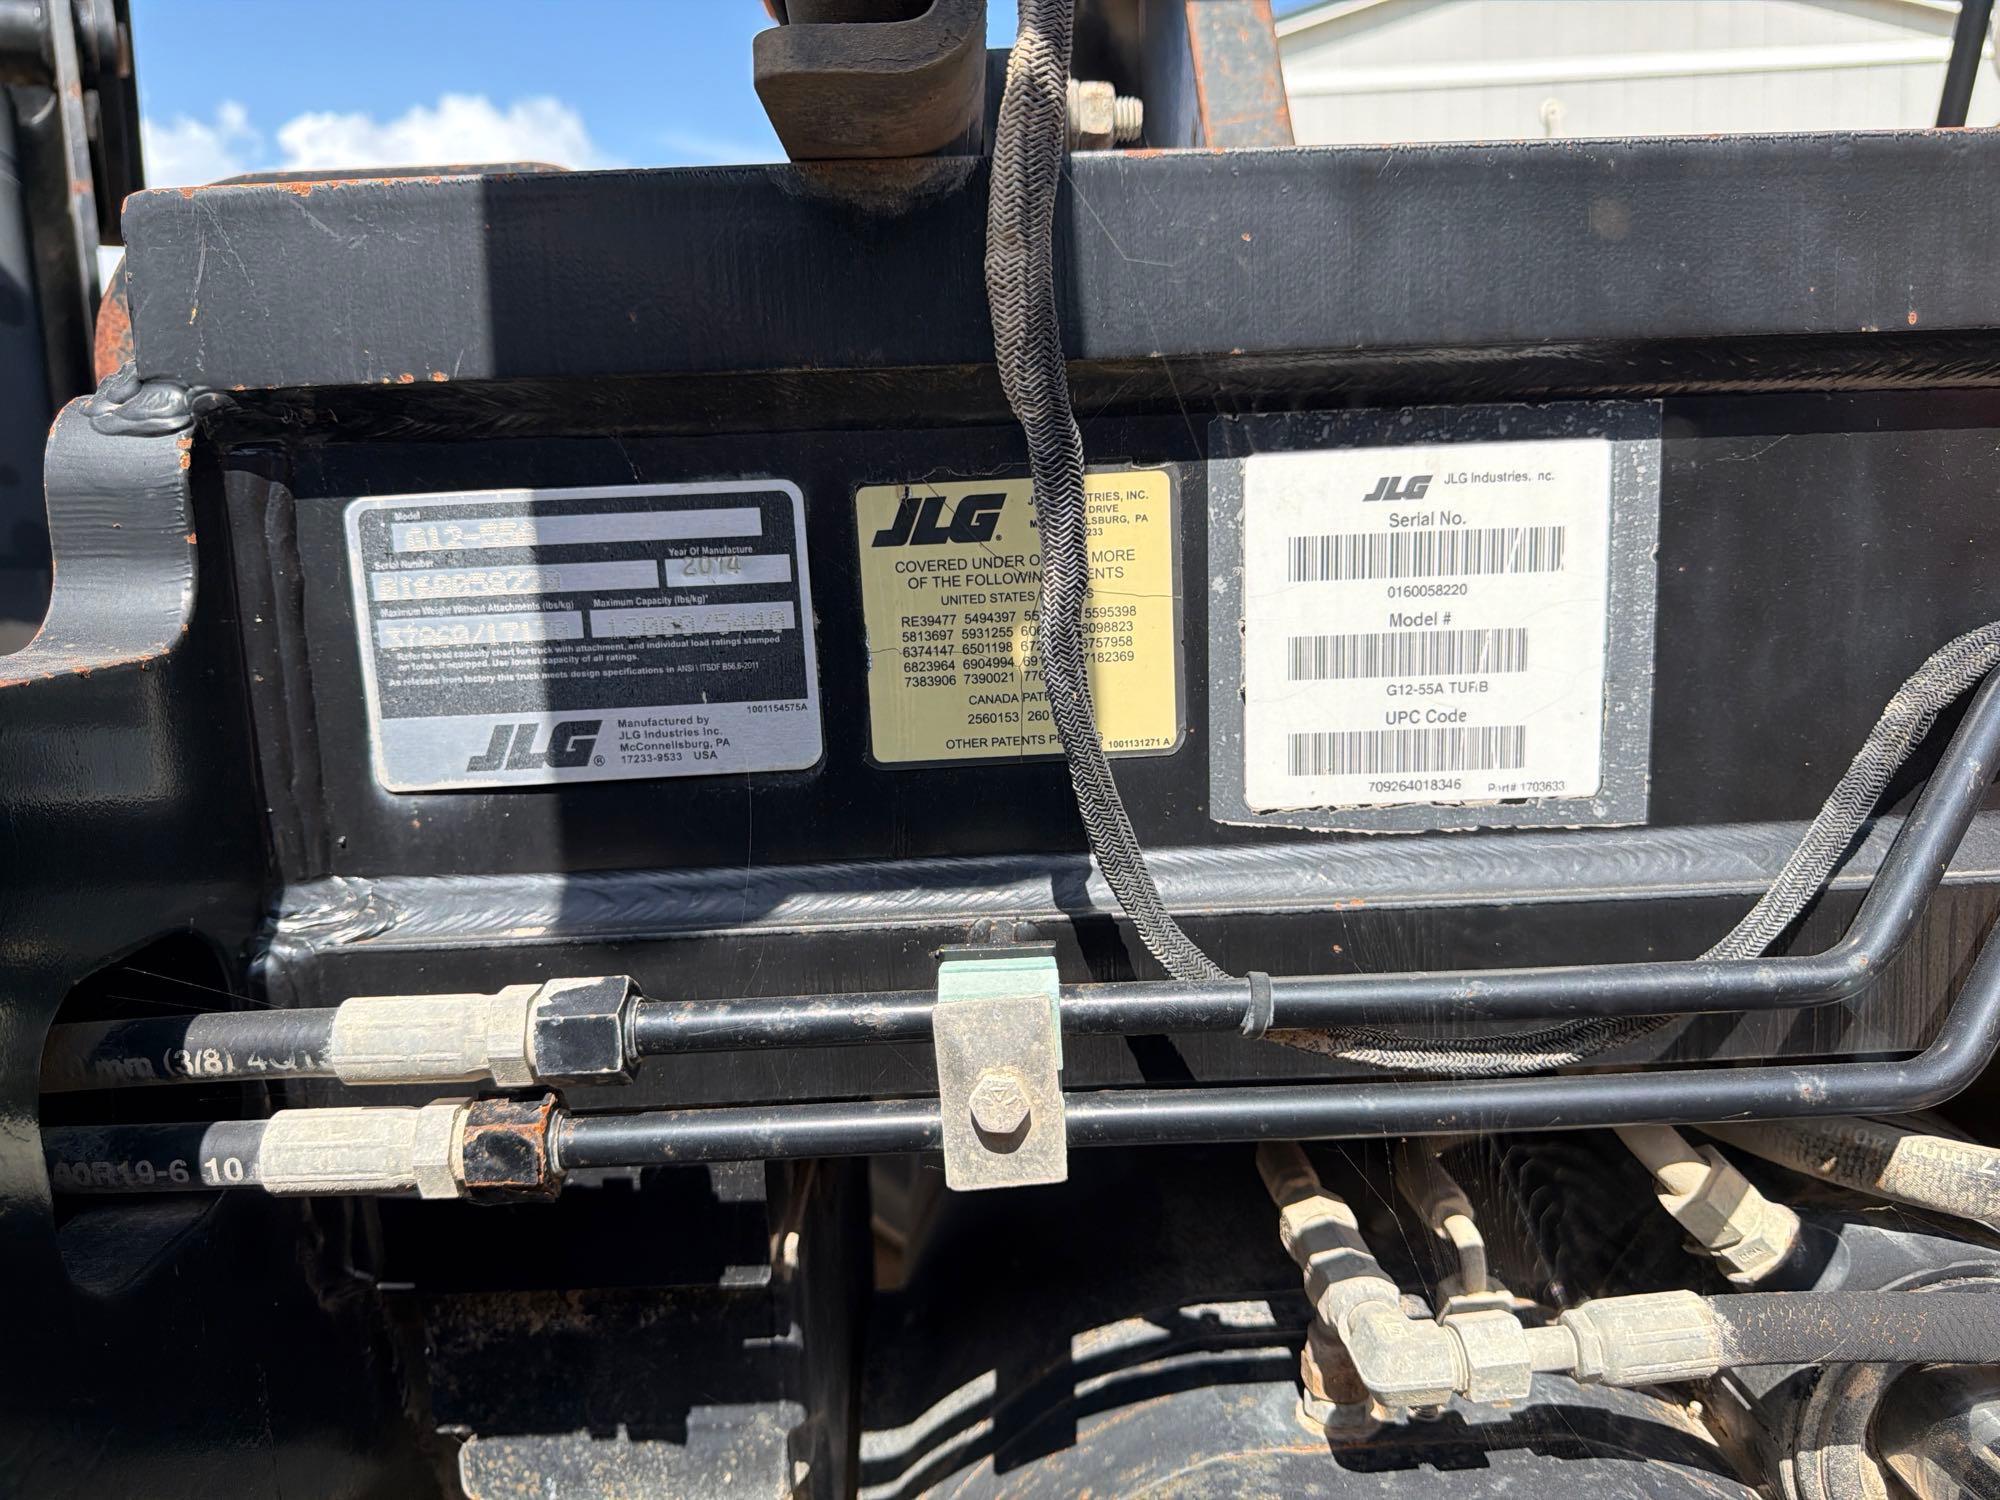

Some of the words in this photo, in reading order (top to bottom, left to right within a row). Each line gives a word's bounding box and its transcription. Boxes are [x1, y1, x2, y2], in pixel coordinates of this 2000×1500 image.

[1444, 472, 1468, 485] JLG
[1471, 470, 1531, 483] Industries,
[1538, 472, 1555, 481] nc.
[1126, 490, 1149, 500] INC.
[1363, 475, 1433, 502] JLG
[394, 511, 420, 521] Model
[1089, 504, 1118, 514] DRIVE
[872, 493, 1007, 547] JLG
[1135, 514, 1149, 523] PA
[1389, 511, 1435, 528] Serial
[1439, 511, 1467, 526] No.
[668, 547, 688, 557] Year
[689, 547, 700, 556] Of
[701, 545, 754, 555] Manufacture
[374, 560, 399, 570] Serial
[400, 558, 434, 569] Number
[682, 555, 742, 577] 2014
[895, 558, 968, 574] COVERED
[972, 556, 1025, 570] UNDER
[1091, 549, 1136, 563] MORE
[908, 576, 929, 590] OF
[933, 574, 963, 588] THE
[966, 571, 1043, 587] FOLLOWIN
[1087, 566, 1124, 580] ENTS
[1388, 583, 1468, 599] 0160058220
[593, 598, 634, 608] Maximum
[636, 596, 673, 608] Capacity
[941, 593, 987, 607] UNITED
[990, 591, 1036, 604] STATES
[381, 607, 421, 618] Maximum
[422, 605, 452, 618] Weight
[453, 604, 486, 615] Without
[487, 602, 540, 613] Attachments
[542, 600, 575, 612] (lbs/kg)
[901, 615, 956, 628] RE39477
[964, 612, 1016, 625] 5494397
[1084, 605, 1137, 619] 5595398
[1389, 612, 1438, 628] Model
[1442, 612, 1452, 625] #
[902, 630, 954, 642] 5813697
[961, 627, 1014, 640] 5931255
[397, 652, 421, 661] Refer
[421, 652, 432, 660] to
[433, 650, 452, 660] load
[454, 649, 490, 660] capacity
[491, 648, 515, 658] chart
[516, 647, 530, 656] for
[530, 646, 553, 656] truck
[555, 645, 574, 655] with
[575, 643, 626, 653] attachment,
[628, 641, 645, 651] and
[647, 639, 689, 649] individual
[691, 638, 710, 648] load
[711, 637, 741, 648] ratings
[743, 635, 781, 646] stamped
[903, 645, 954, 658] 6374147
[962, 642, 1014, 655] 6501198
[492, 658, 510, 667] Use
[511, 657, 541, 666] lowest
[542, 655, 580, 666] capacity
[582, 654, 592, 663] of
[593, 654, 604, 663] all
[606, 653, 640, 663] ratings.
[904, 660, 955, 674] 6823964
[963, 657, 1015, 670] 6904994
[389, 679, 402, 687] As
[403, 677, 441, 686] released
[442, 675, 462, 684] from
[464, 673, 495, 685] factory
[496, 673, 515, 682] this
[516, 671, 541, 681] truck
[542, 670, 568, 680] meets
[570, 668, 600, 680] design
[602, 666, 664, 678] specifications
[666, 665, 675, 673] in
[905, 675, 957, 688] 7383906
[964, 672, 1015, 685] 7390021
[1386, 683, 1444, 696] G12-55A
[969, 692, 1019, 705] CANADA
[1023, 690, 1050, 702] PATE
[746, 703, 808, 714] 1001154575A
[618, 717, 693, 729] Manufactured
[697, 716, 710, 727] by
[968, 711, 1019, 725] 2560153
[1385, 710, 1421, 726] UPC
[1426, 708, 1467, 723] Code
[619, 730, 641, 741] JLG
[644, 728, 701, 739] Industries
[703, 726, 723, 736] Inc.
[466, 719, 603, 773] JLG
[620, 739, 713, 753] McConnellsburg,
[716, 738, 731, 748] PA
[946, 737, 990, 750] OTHER
[991, 734, 1046, 748] PATENTS
[1108, 738, 1160, 749] 1001131271
[1161, 737, 1171, 746] A
[694, 751, 718, 761] USA
[1368, 778, 1462, 793] 709264018346
[1521, 780, 1566, 792] 1703633
[163, 1048, 236, 1076] (3/8)
[203, 1157, 244, 1183] 10
